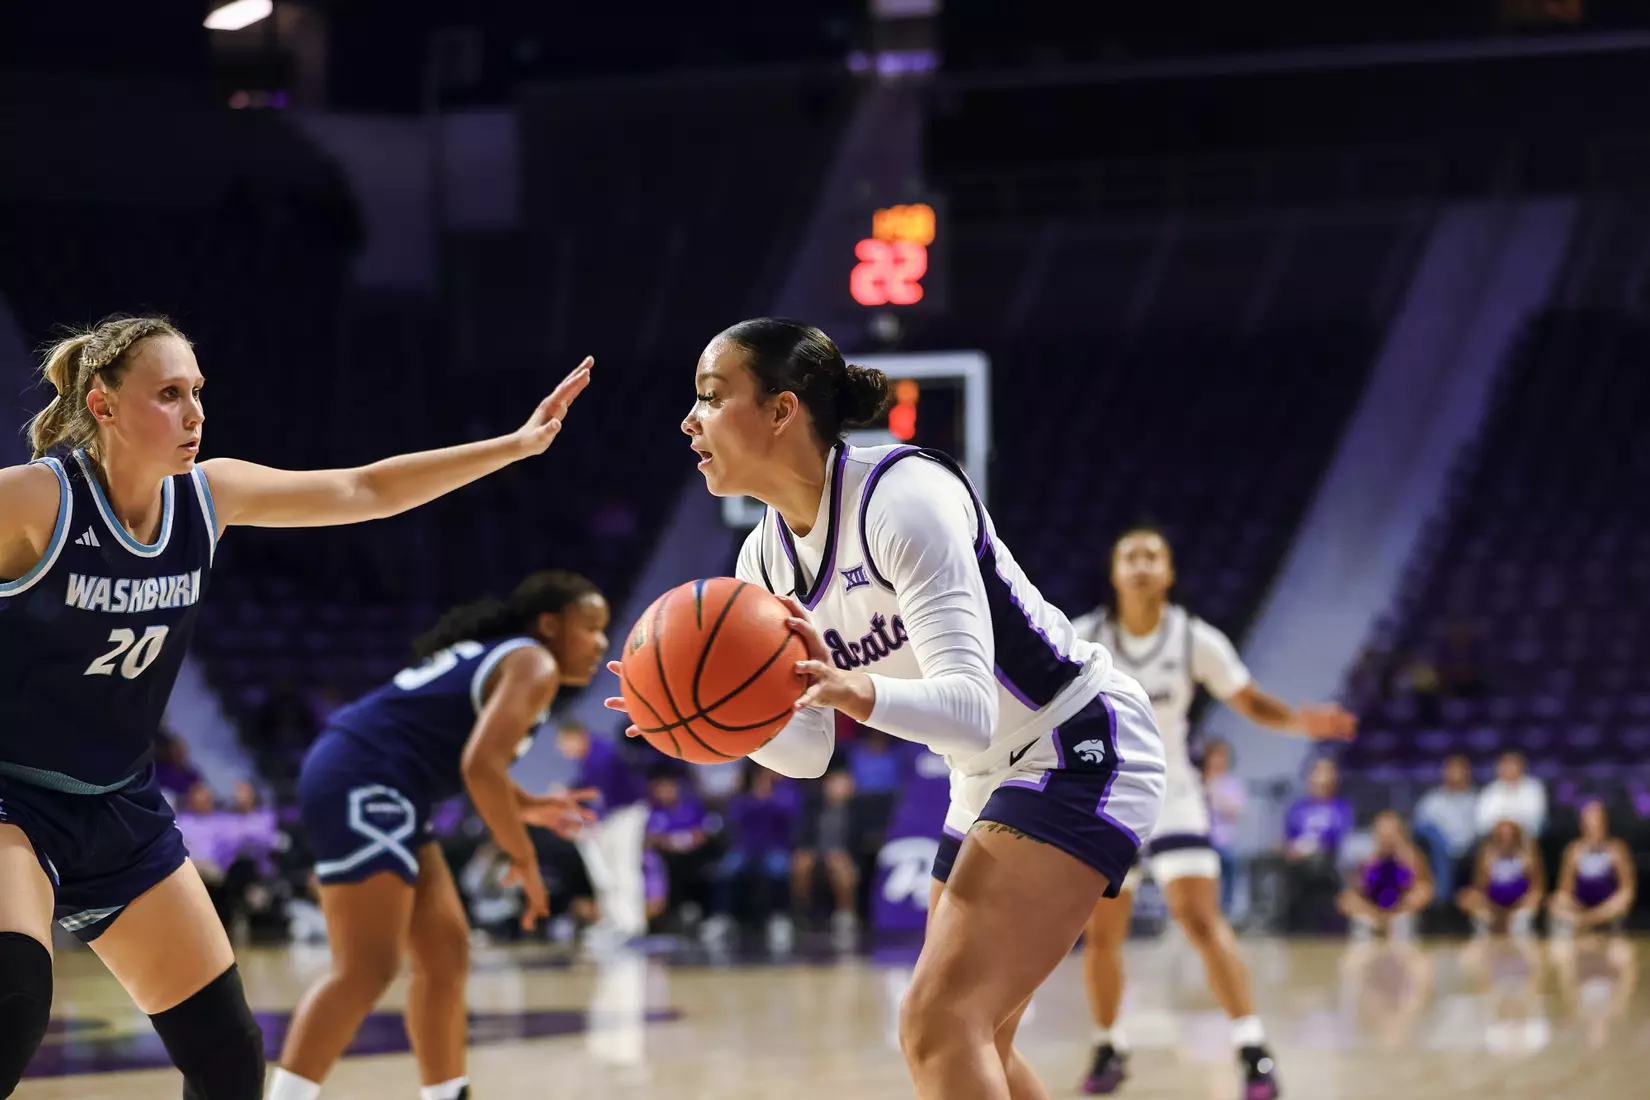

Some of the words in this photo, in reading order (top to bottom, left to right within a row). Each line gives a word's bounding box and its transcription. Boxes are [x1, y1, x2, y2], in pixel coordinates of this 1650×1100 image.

[65, 567, 202, 613] WASHBURN
[83, 624, 170, 680] 20
[823, 611, 909, 672] dcats
